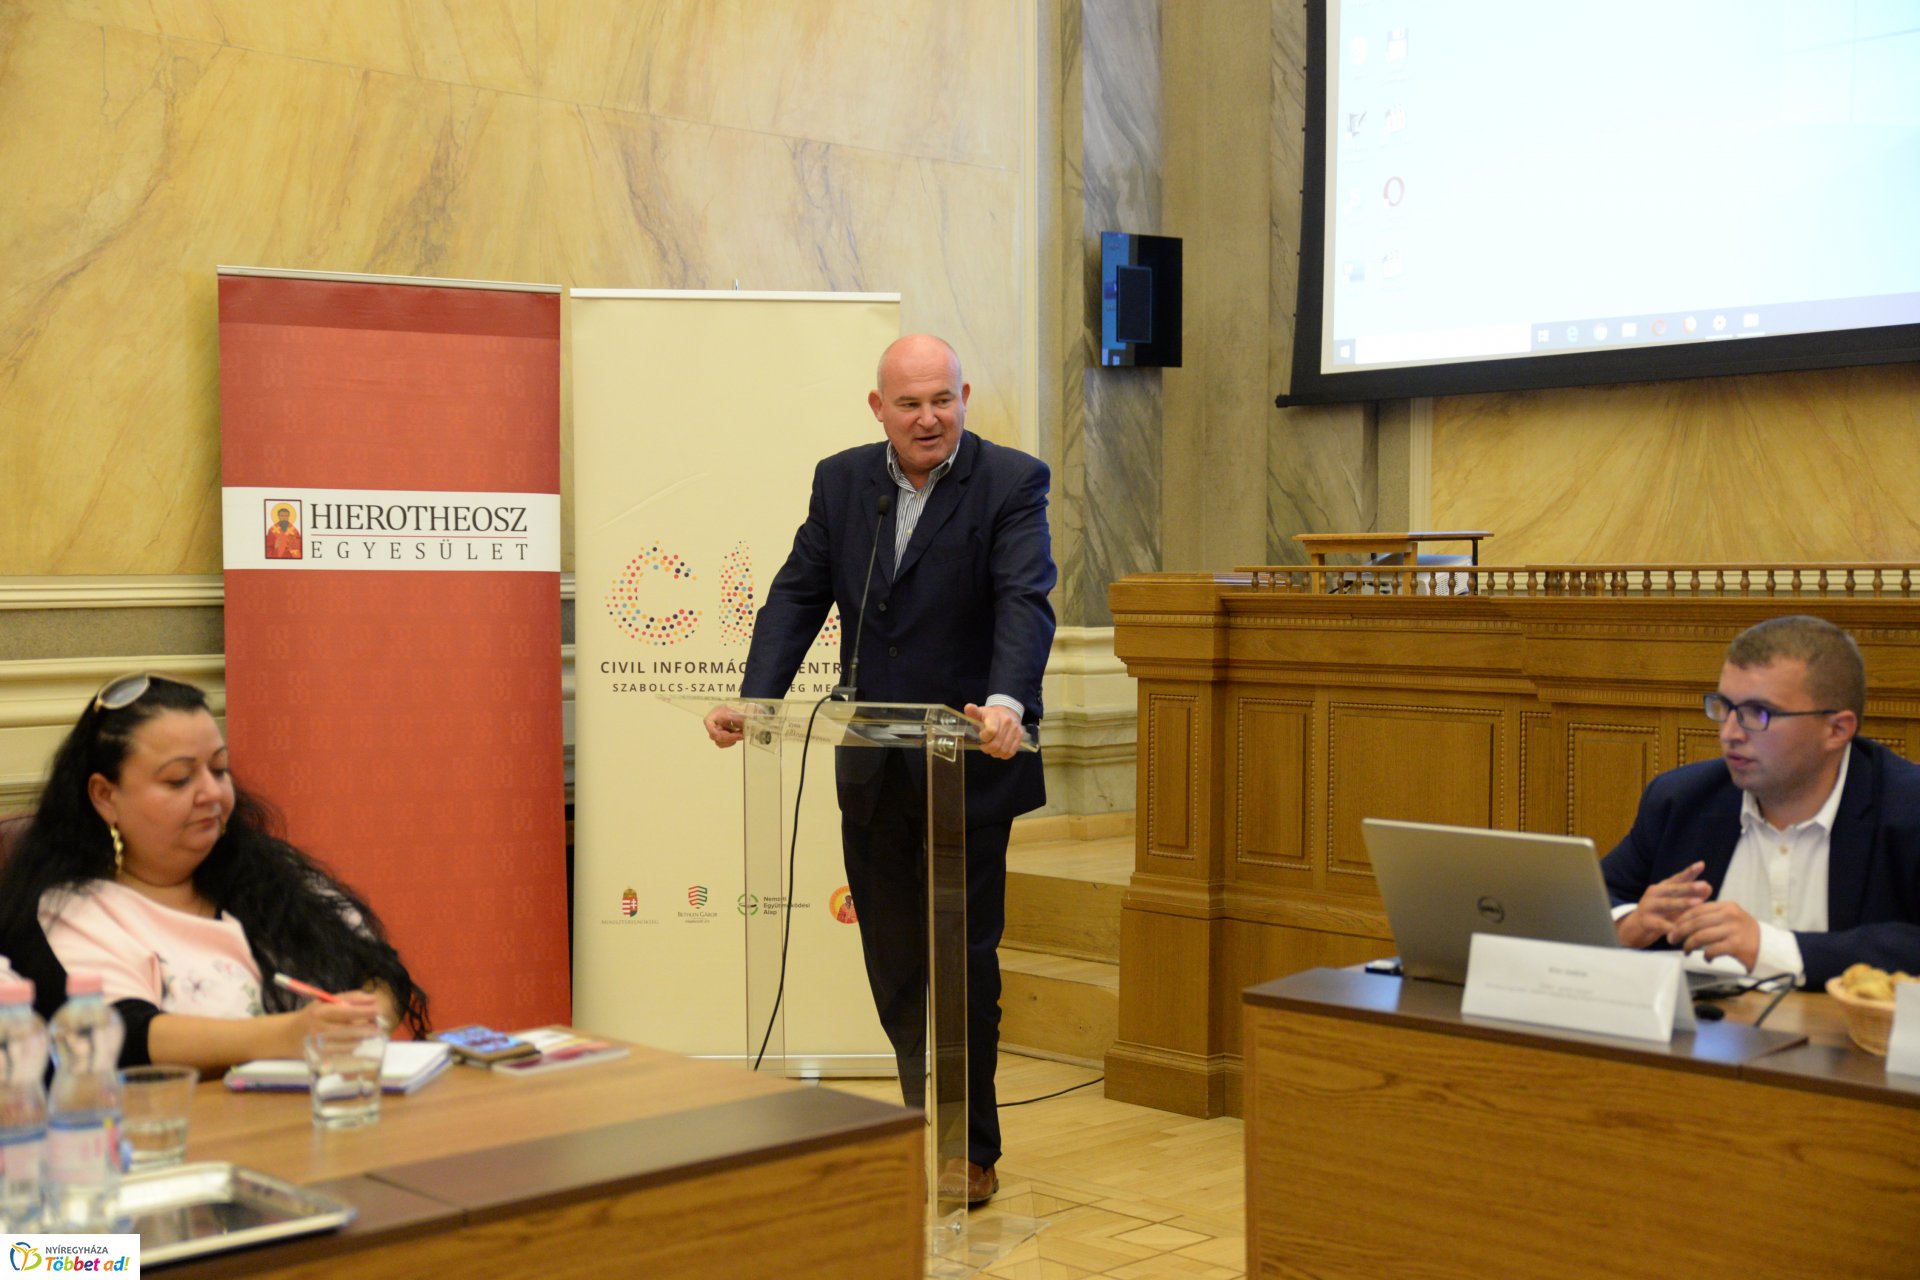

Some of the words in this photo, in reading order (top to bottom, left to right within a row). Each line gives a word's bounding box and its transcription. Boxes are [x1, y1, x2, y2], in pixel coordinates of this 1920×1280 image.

[310, 503, 528, 532] HIEROTHEOSZ
[310, 539, 528, 560] EGYESÜLET
[600, 661, 646, 674] CIVIL
[653, 658, 747, 674] INFORMÁC
